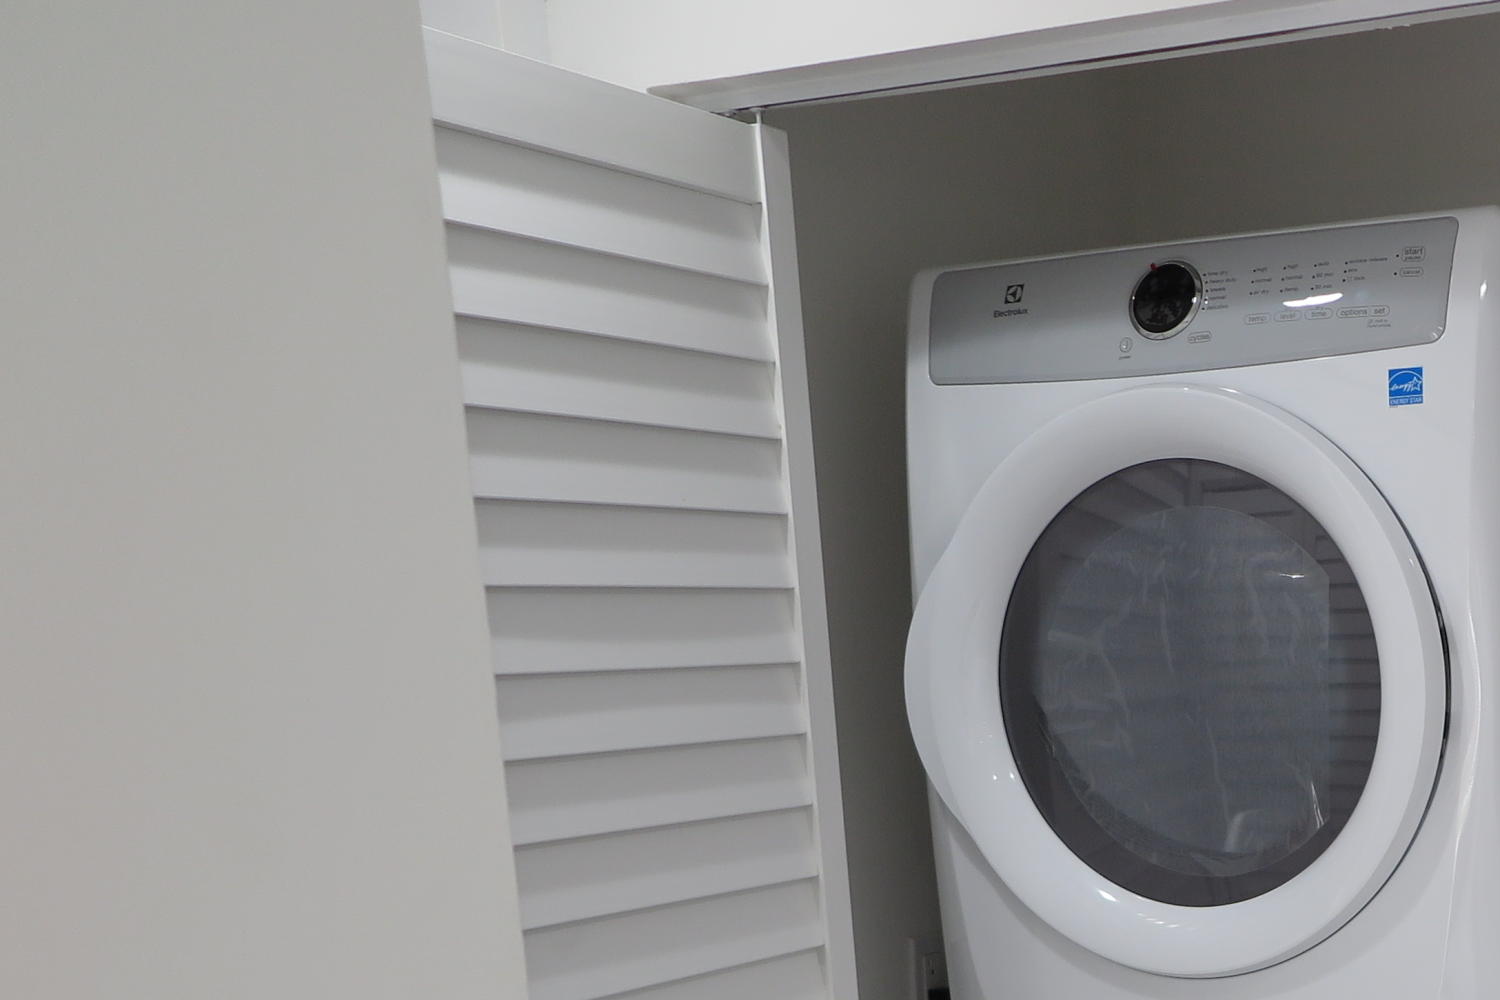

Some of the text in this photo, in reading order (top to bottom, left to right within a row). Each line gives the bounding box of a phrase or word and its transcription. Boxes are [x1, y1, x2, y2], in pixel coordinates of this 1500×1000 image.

[993, 308, 1029, 319] Electrolux
[1340, 307, 1386, 319] options set
